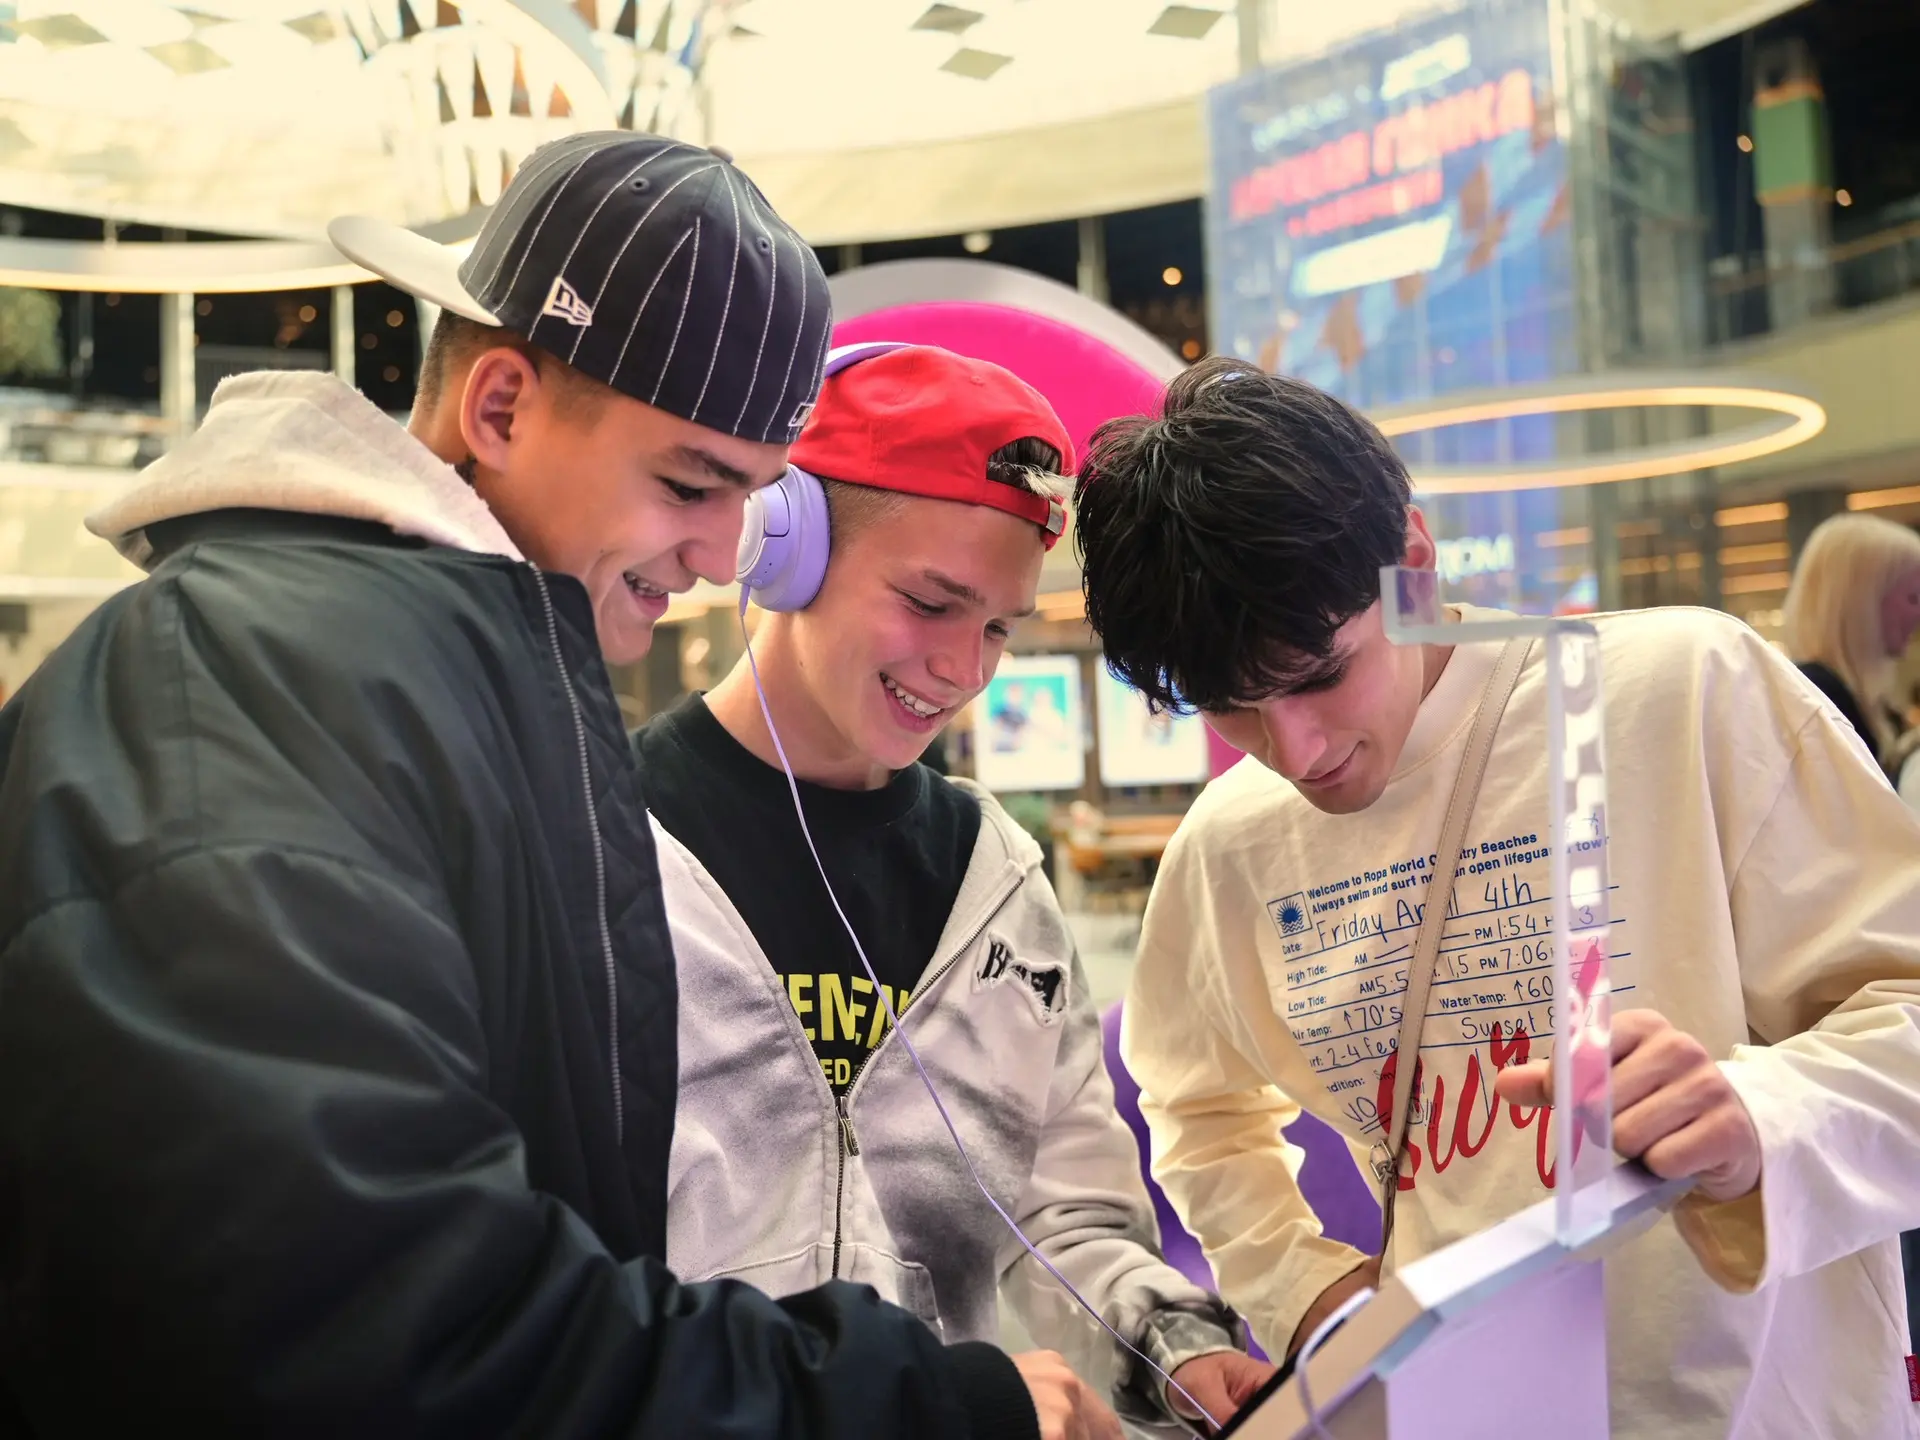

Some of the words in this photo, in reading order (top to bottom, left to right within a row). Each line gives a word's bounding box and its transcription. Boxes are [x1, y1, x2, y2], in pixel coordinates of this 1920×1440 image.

[1307, 879, 1350, 900] Welcome
[1351, 876, 1362, 887] to
[1364, 868, 1388, 884] Ropa
[1390, 857, 1426, 874] World
[1429, 847, 1477, 866] Ctry
[1481, 833, 1537, 854] Beaches
[1312, 896, 1345, 915] Always
[1348, 889, 1370, 903] swim
[1372, 882, 1388, 896] and
[1391, 875, 1417, 890] surf
[1469, 858, 1500, 875] open
[1504, 843, 1571, 867] lifegua
[1316, 912, 1388, 950] Friday
[1396, 887, 1459, 927] Ail
[1484, 873, 1533, 910] 4th
[1287, 970, 1305, 983] High
[1307, 964, 1328, 976] Tide:
[1354, 953, 1368, 965] AM
[1474, 927, 1493, 940] PM
[1497, 913, 1537, 940] 1:54
[1288, 1002, 1305, 1012] Low
[1307, 996, 1327, 1008] Tide:
[1359, 980, 1375, 994] AM
[1479, 957, 1499, 970] PM
[1307, 1026, 1332, 1038] Temp:
[1439, 997, 1472, 1009] Water
[1474, 993, 1507, 1006] Temp:
[1363, 1030, 1400, 1057] fee
[1461, 1011, 1537, 1039] Sunset
[1327, 1077, 1365, 1093] dition:
